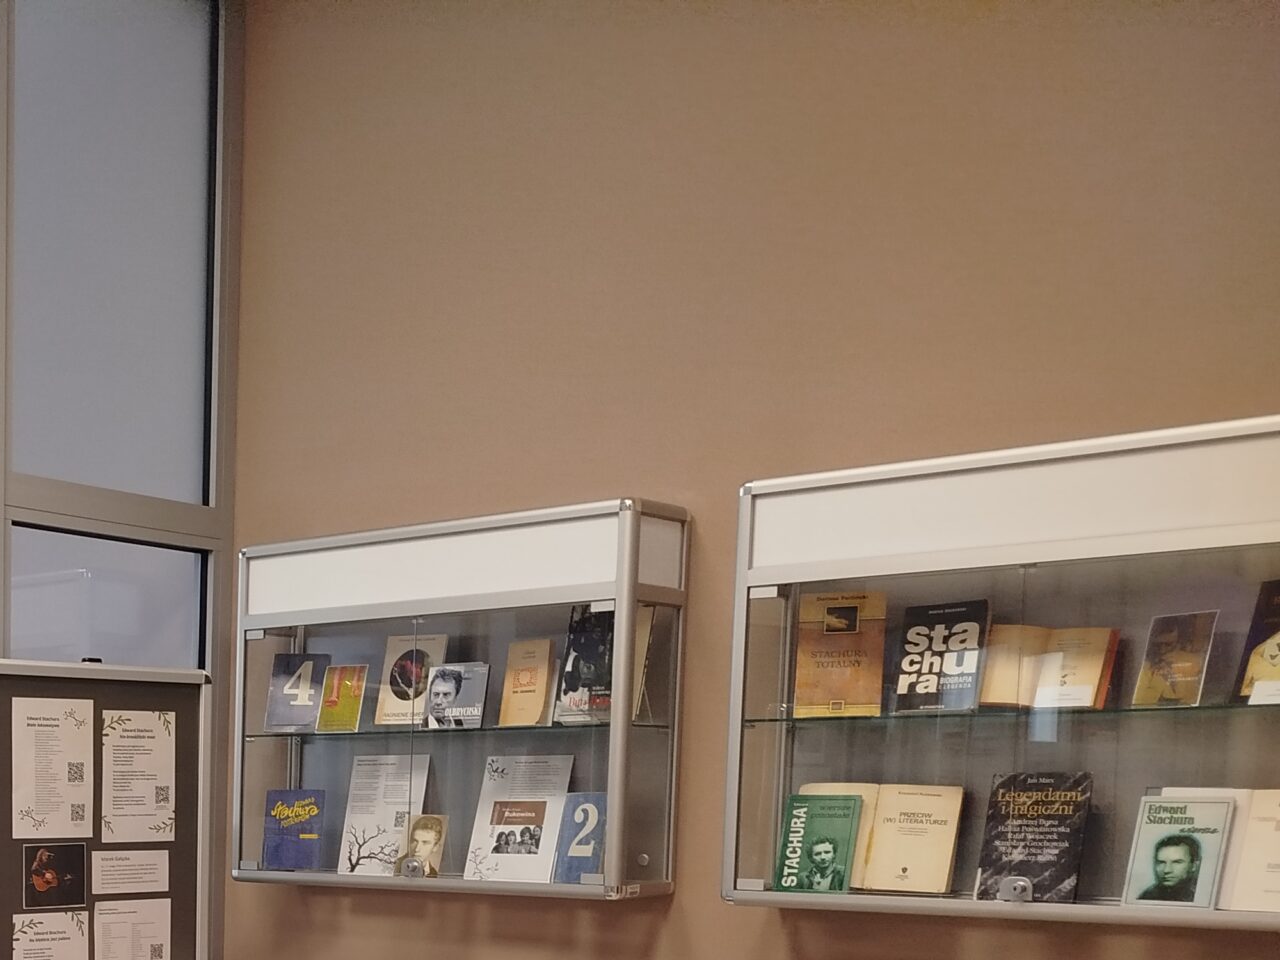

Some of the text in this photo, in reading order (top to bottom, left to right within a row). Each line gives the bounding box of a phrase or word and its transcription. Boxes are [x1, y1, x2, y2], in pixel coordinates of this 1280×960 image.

[904, 621, 980, 653] sta
[810, 649, 868, 659] STACHURA
[816, 659, 862, 668] TOTALNY
[901, 650, 979, 675] chu
[283, 661, 315, 706] 4
[896, 674, 938, 695] ra
[939, 675, 973, 684] BIOGRAFIA
[445, 706, 481, 717] OLBRYCHSKI
[1148, 804, 1187, 815] Edward
[898, 818, 949, 826] LITERATURZE
[1145, 815, 1195, 825] Stachura
[567, 803, 599, 857] 2
[782, 807, 808, 887] STACHURA
